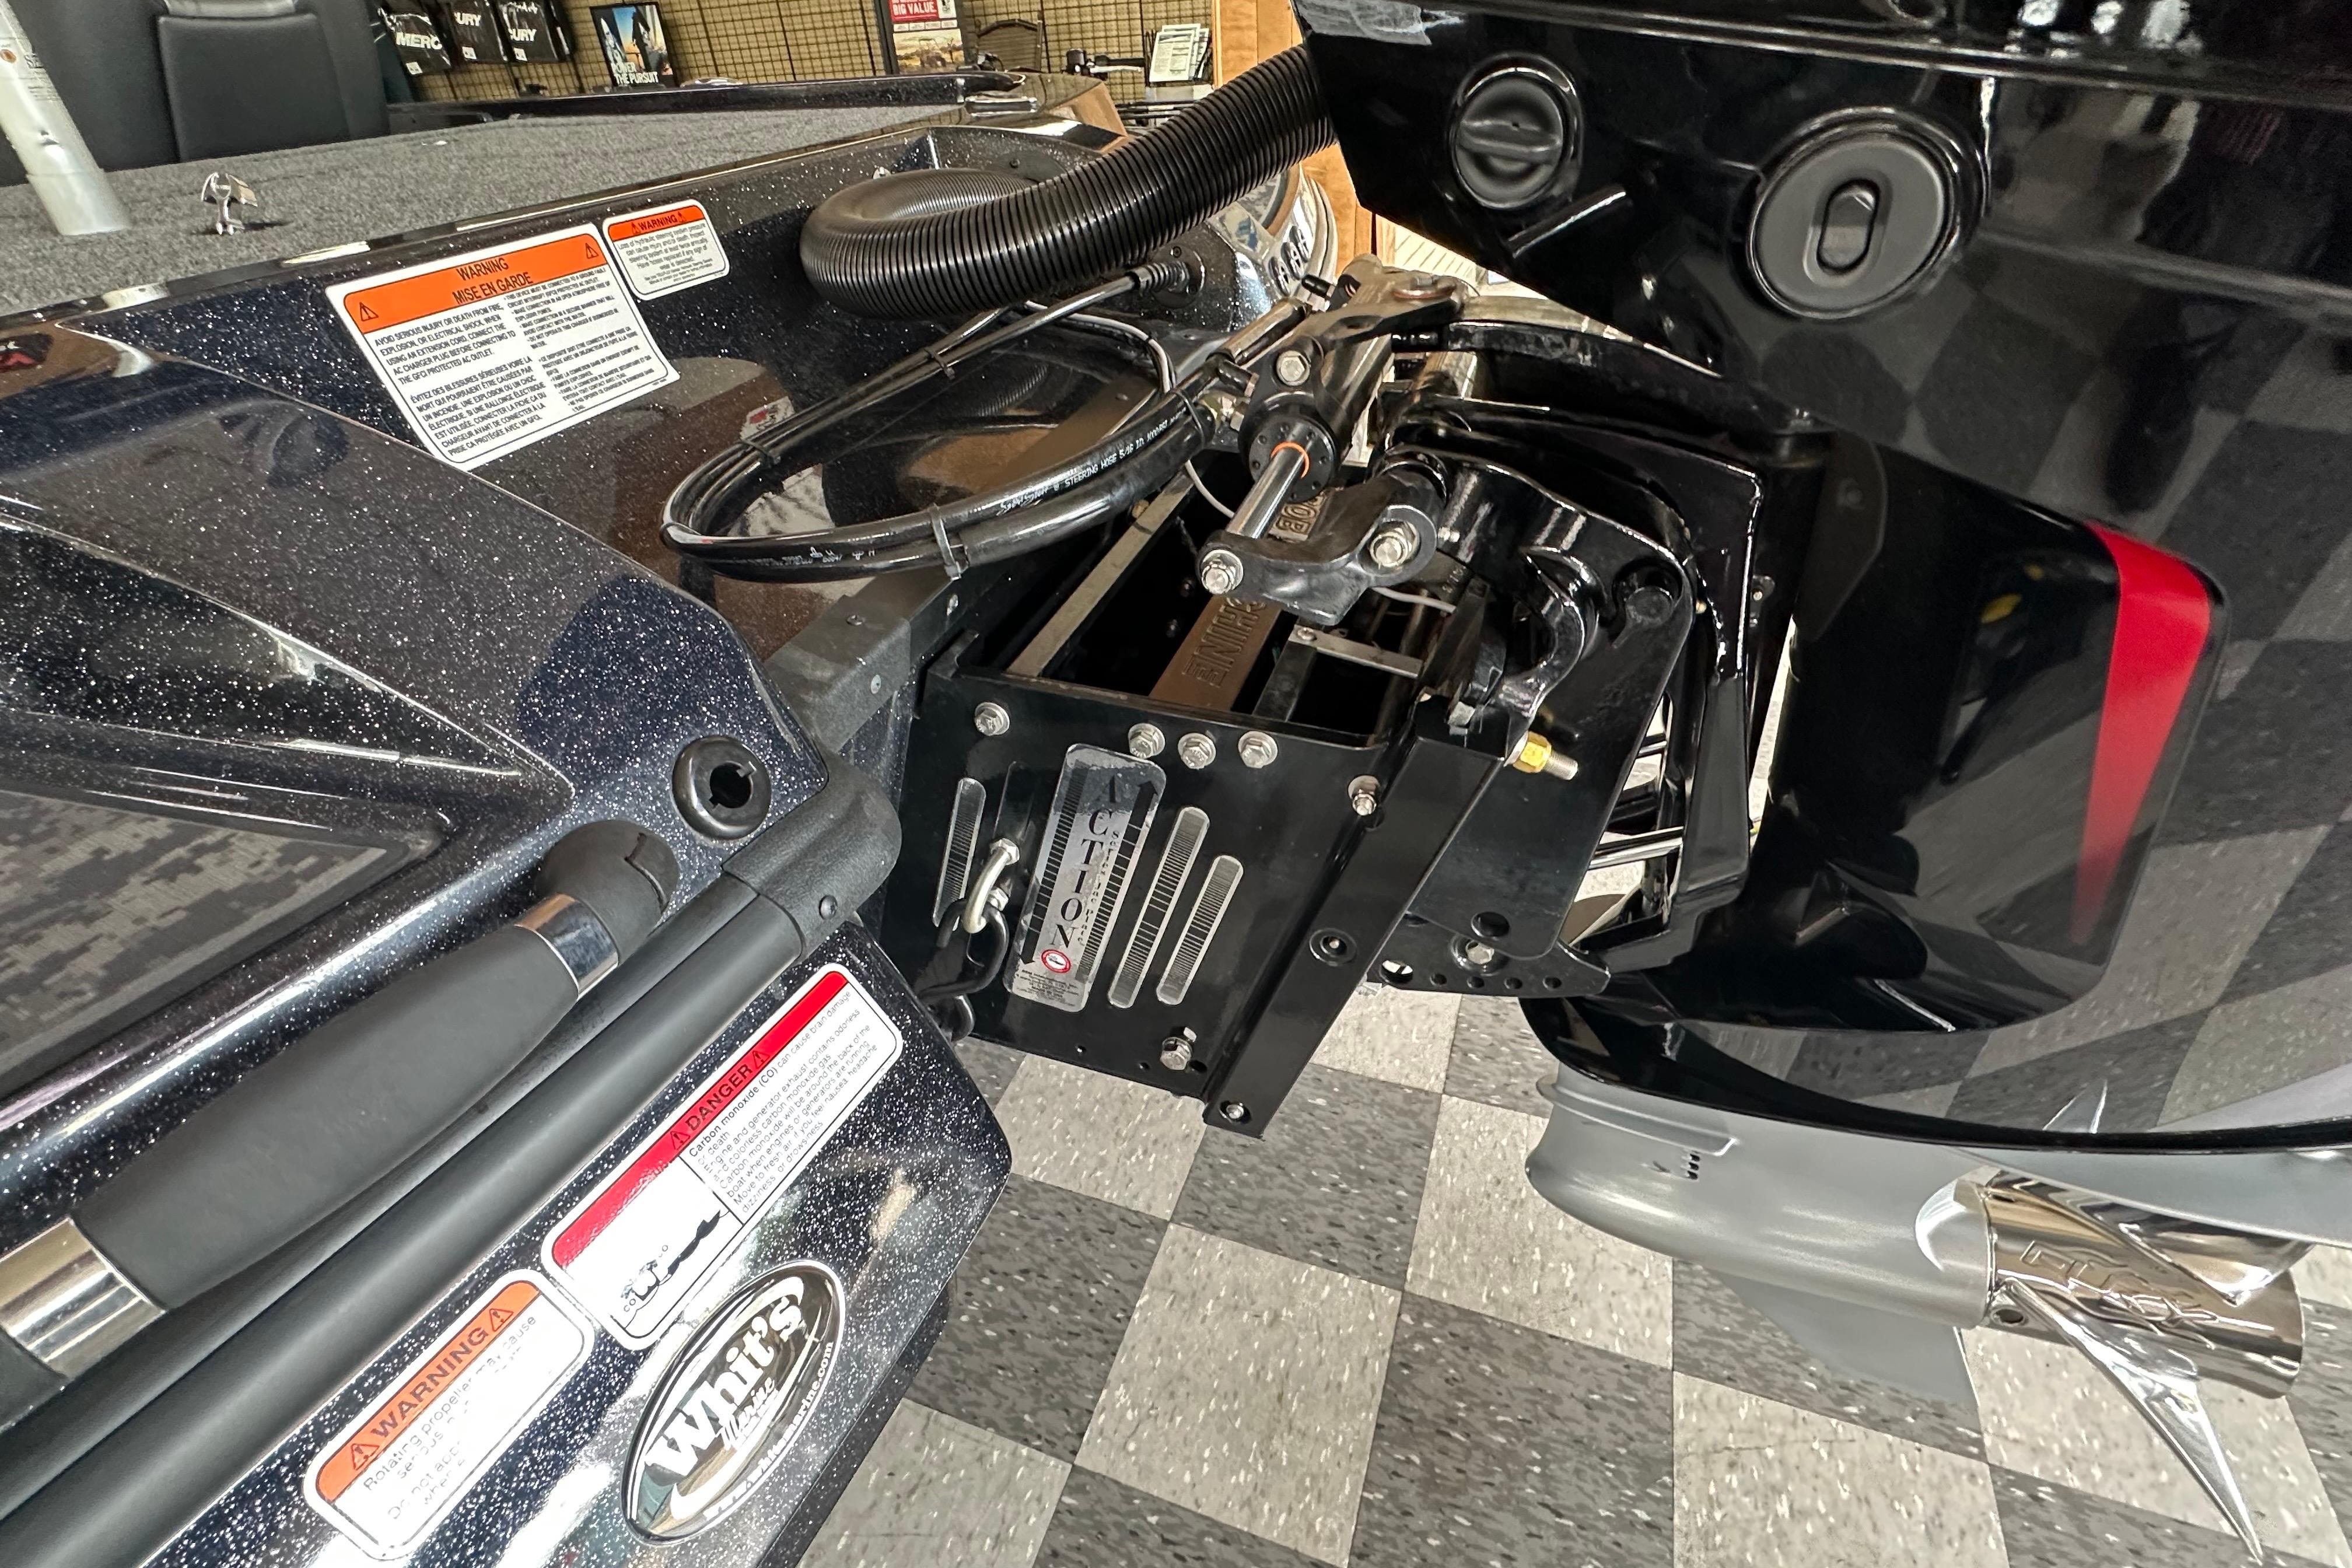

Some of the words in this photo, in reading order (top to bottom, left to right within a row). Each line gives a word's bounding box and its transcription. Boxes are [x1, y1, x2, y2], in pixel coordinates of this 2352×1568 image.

[892, 4, 907, 16] BIG
[907, 1, 937, 15] VALUE
[611, 62, 637, 74] POWER
[614, 73, 629, 85] THE
[628, 71, 659, 84] PURSUIT
[638, 213, 678, 232] WARNING
[456, 257, 508, 280] WARNING
[452, 286, 482, 304] MISE
[479, 281, 498, 297] EN
[496, 272, 533, 291] GARDE
[374, 334, 395, 346] AVOID
[394, 326, 422, 340] SERIOUS
[421, 320, 443, 332] INJURY
[443, 317, 454, 326] OR
[452, 312, 473, 323] DEATH
[471, 306, 489, 317] FROM
[416, 335, 428, 345] OR
[426, 326, 463, 341] ELECTRICAL
[483, 314, 501, 324] WHEN
[386, 354, 407, 366] USING
[407, 351, 417, 359] AN
[415, 341, 450, 356] EXTENSION
[467, 326, 494, 340] CONNECT
[494, 322, 506, 331] THE
[393, 366, 404, 376] AC
[402, 357, 433, 372] CHARGER
[432, 351, 450, 362] PLUG
[448, 344, 473, 356] BEFORE
[472, 332, 508, 349] CONNECTING
[397, 374, 413, 384] THE
[426, 358, 462, 374] PROTECTED
[461, 355, 471, 363] AC
[431, 386, 445, 396] DES
[523, 355, 533, 363] LA
[422, 413, 433, 422] UN
[460, 398, 474, 407] UNE
[433, 429, 447, 439] EST
[473, 407, 508, 424] CONNECTER
[474, 422, 493, 435] AVANT
[491, 419, 502, 428] DE
[465, 440, 477, 449] CA
[1065, 464, 1098, 488] STEERING
[1101, 453, 1117, 469] HOSE
[1048, 774, 1123, 951] ACTION
[689, 1125, 721, 1157] Carbon
[720, 1086, 759, 1125] monoxide
[758, 1066, 778, 1087] (CO)
[777, 1053, 790, 1068] can
[790, 1032, 810, 1054] cause
[809, 1016, 827, 1034] brain
[826, 991, 850, 1017] damage
[733, 1126, 748, 1144] and
[748, 1091, 780, 1129] generator
[782, 1063, 807, 1092] exhaust
[808, 1035, 835, 1064] contains
[834, 1009, 860, 1036] odorless
[685, 1063, 753, 1130] DANGER
[719, 1158, 748, 1189] Carbon
[748, 1120, 783, 1157] monoxide
[783, 1105, 795, 1120] will
[793, 1096, 805, 1108] be
[804, 1070, 828, 1097] around
[826, 1059, 838, 1072] the
[837, 1044, 853, 1060] back
[853, 1033, 860, 1044] of
[859, 1025, 870, 1036] the
[729, 1129, 762, 1164] colorless
[761, 1102, 786, 1129] carbon
[786, 1067, 818, 1101] monoxide
[818, 1054, 831, 1069] gas
[726, 1177, 746, 1198] boat
[746, 1154, 765, 1177] when
[766, 1124, 793, 1154] engines
[802, 1077, 835, 1116] generators
[835, 1065, 846, 1078] are
[845, 1040, 870, 1066] running
[733, 1181, 755, 1205] Move
[754, 1171, 764, 1181] to
[763, 1151, 780, 1171] fresh
[799, 1119, 813, 1135] you
[811, 1104, 824, 1117] feel
[847, 1045, 877, 1075] headache
[697, 1154, 705, 1165] or
[708, 1131, 730, 1154] death
[777, 1162, 785, 1172] or
[623, 1297, 638, 1312] CO
[372, 1328, 487, 1436] WARNING
[645, 1296, 803, 1476] Whit's
